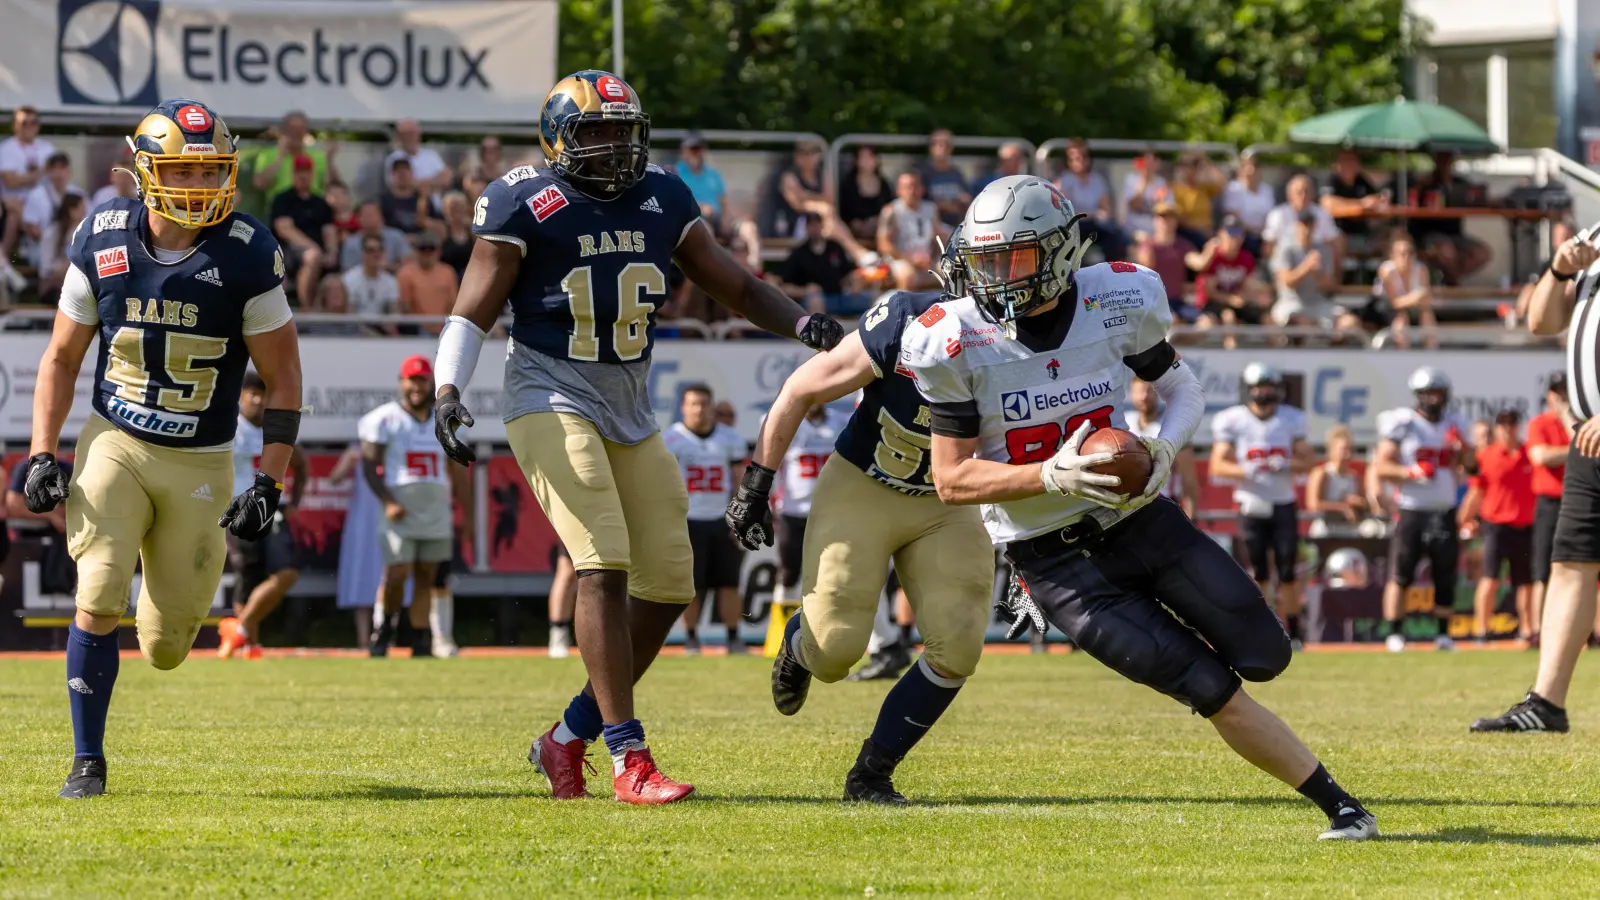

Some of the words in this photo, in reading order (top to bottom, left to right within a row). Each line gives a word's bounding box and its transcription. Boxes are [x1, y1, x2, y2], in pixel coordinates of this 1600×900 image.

[181, 25, 491, 90] Electrolux
[640, 204, 664, 214] adidas
[578, 230, 646, 257] RAMS
[974, 233, 1001, 242] Riddell
[195, 274, 223, 287] adidas
[1097, 288, 1141, 303] Stadtwerke
[1100, 296, 1144, 311] Rothenburg
[126, 297, 199, 328] RAMS
[560, 262, 666, 362] 16
[104, 326, 230, 413] 45
[1035, 380, 1113, 411] Electrolux
[110, 398, 196, 435] Tucher
[874, 406, 932, 484] 5
[404, 452, 438, 477] 51
[686, 464, 724, 492] 22
